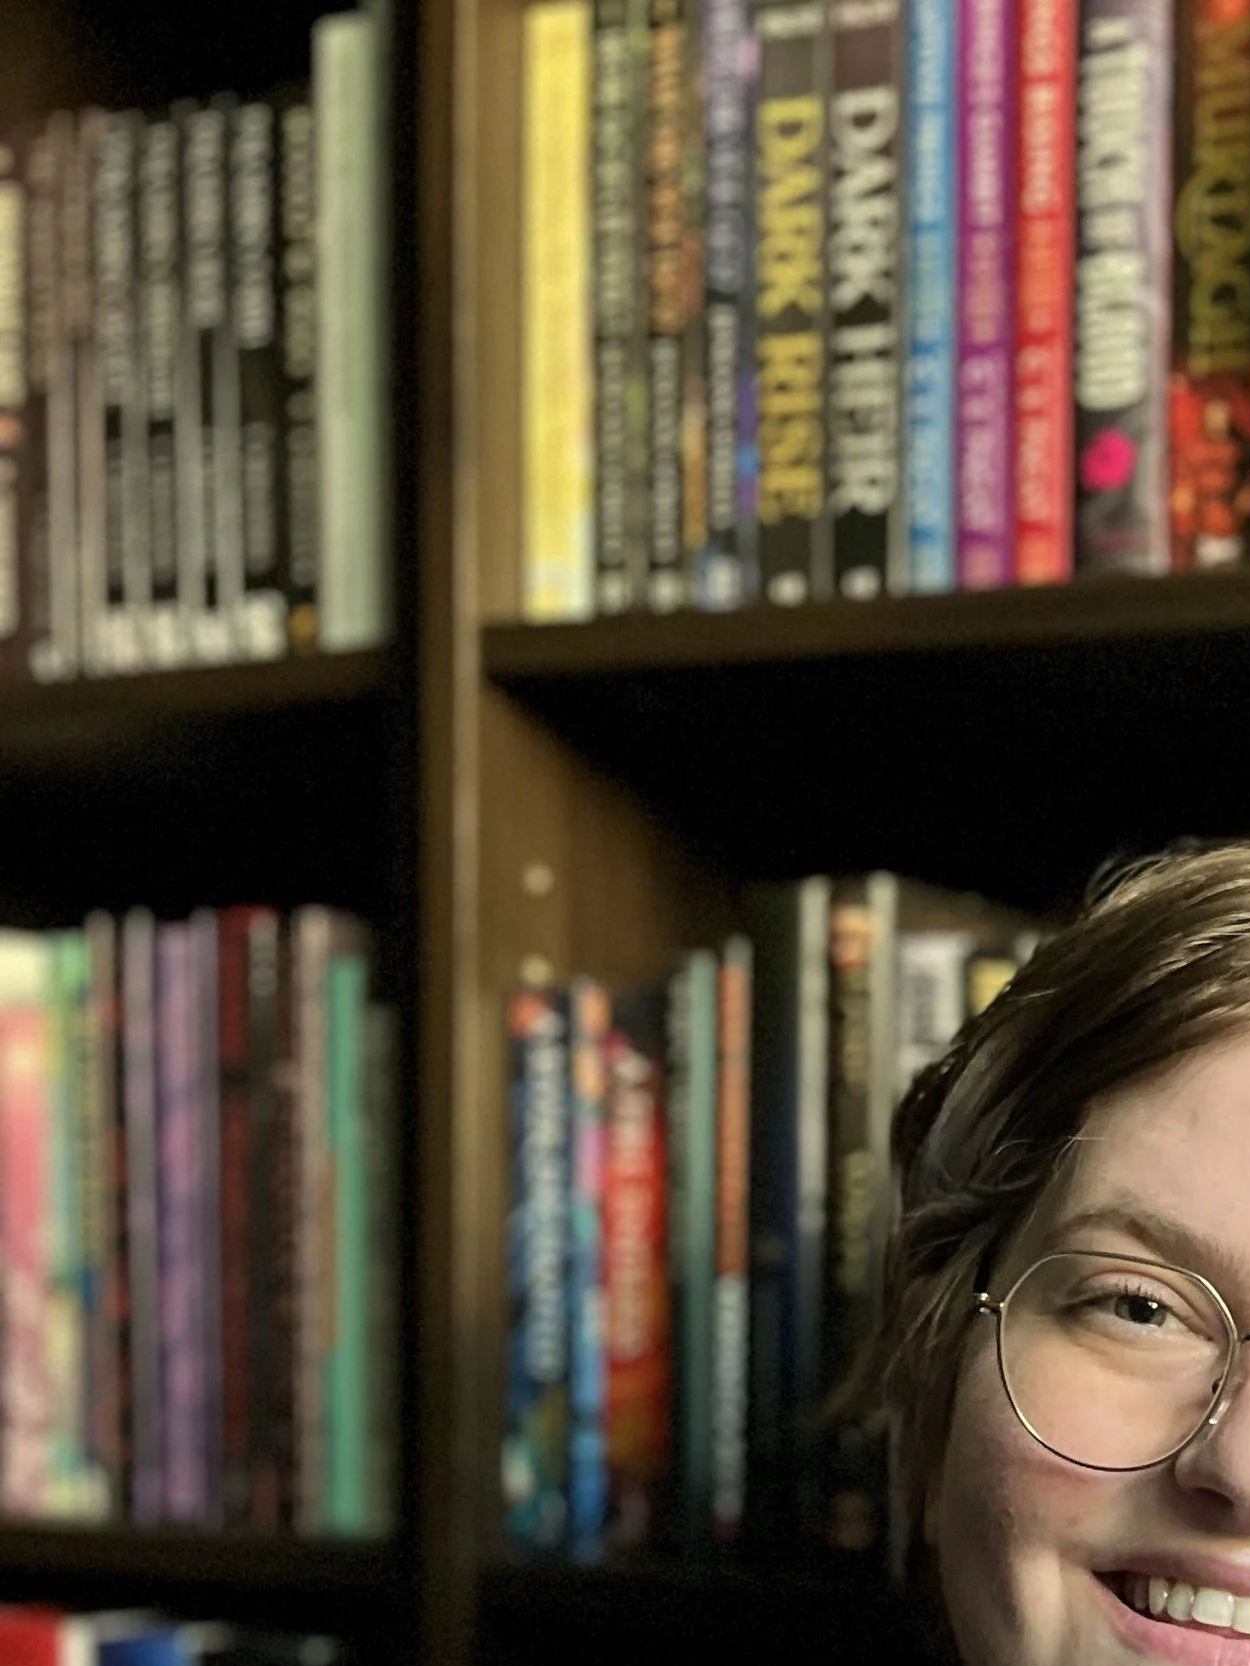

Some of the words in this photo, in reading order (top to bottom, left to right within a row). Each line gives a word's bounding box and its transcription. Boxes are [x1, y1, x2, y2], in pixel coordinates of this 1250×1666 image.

[757, 96, 823, 319] DARK
[830, 86, 898, 312] DARK
[756, 331, 824, 526] RISE
[829, 324, 898, 515] HEIR
